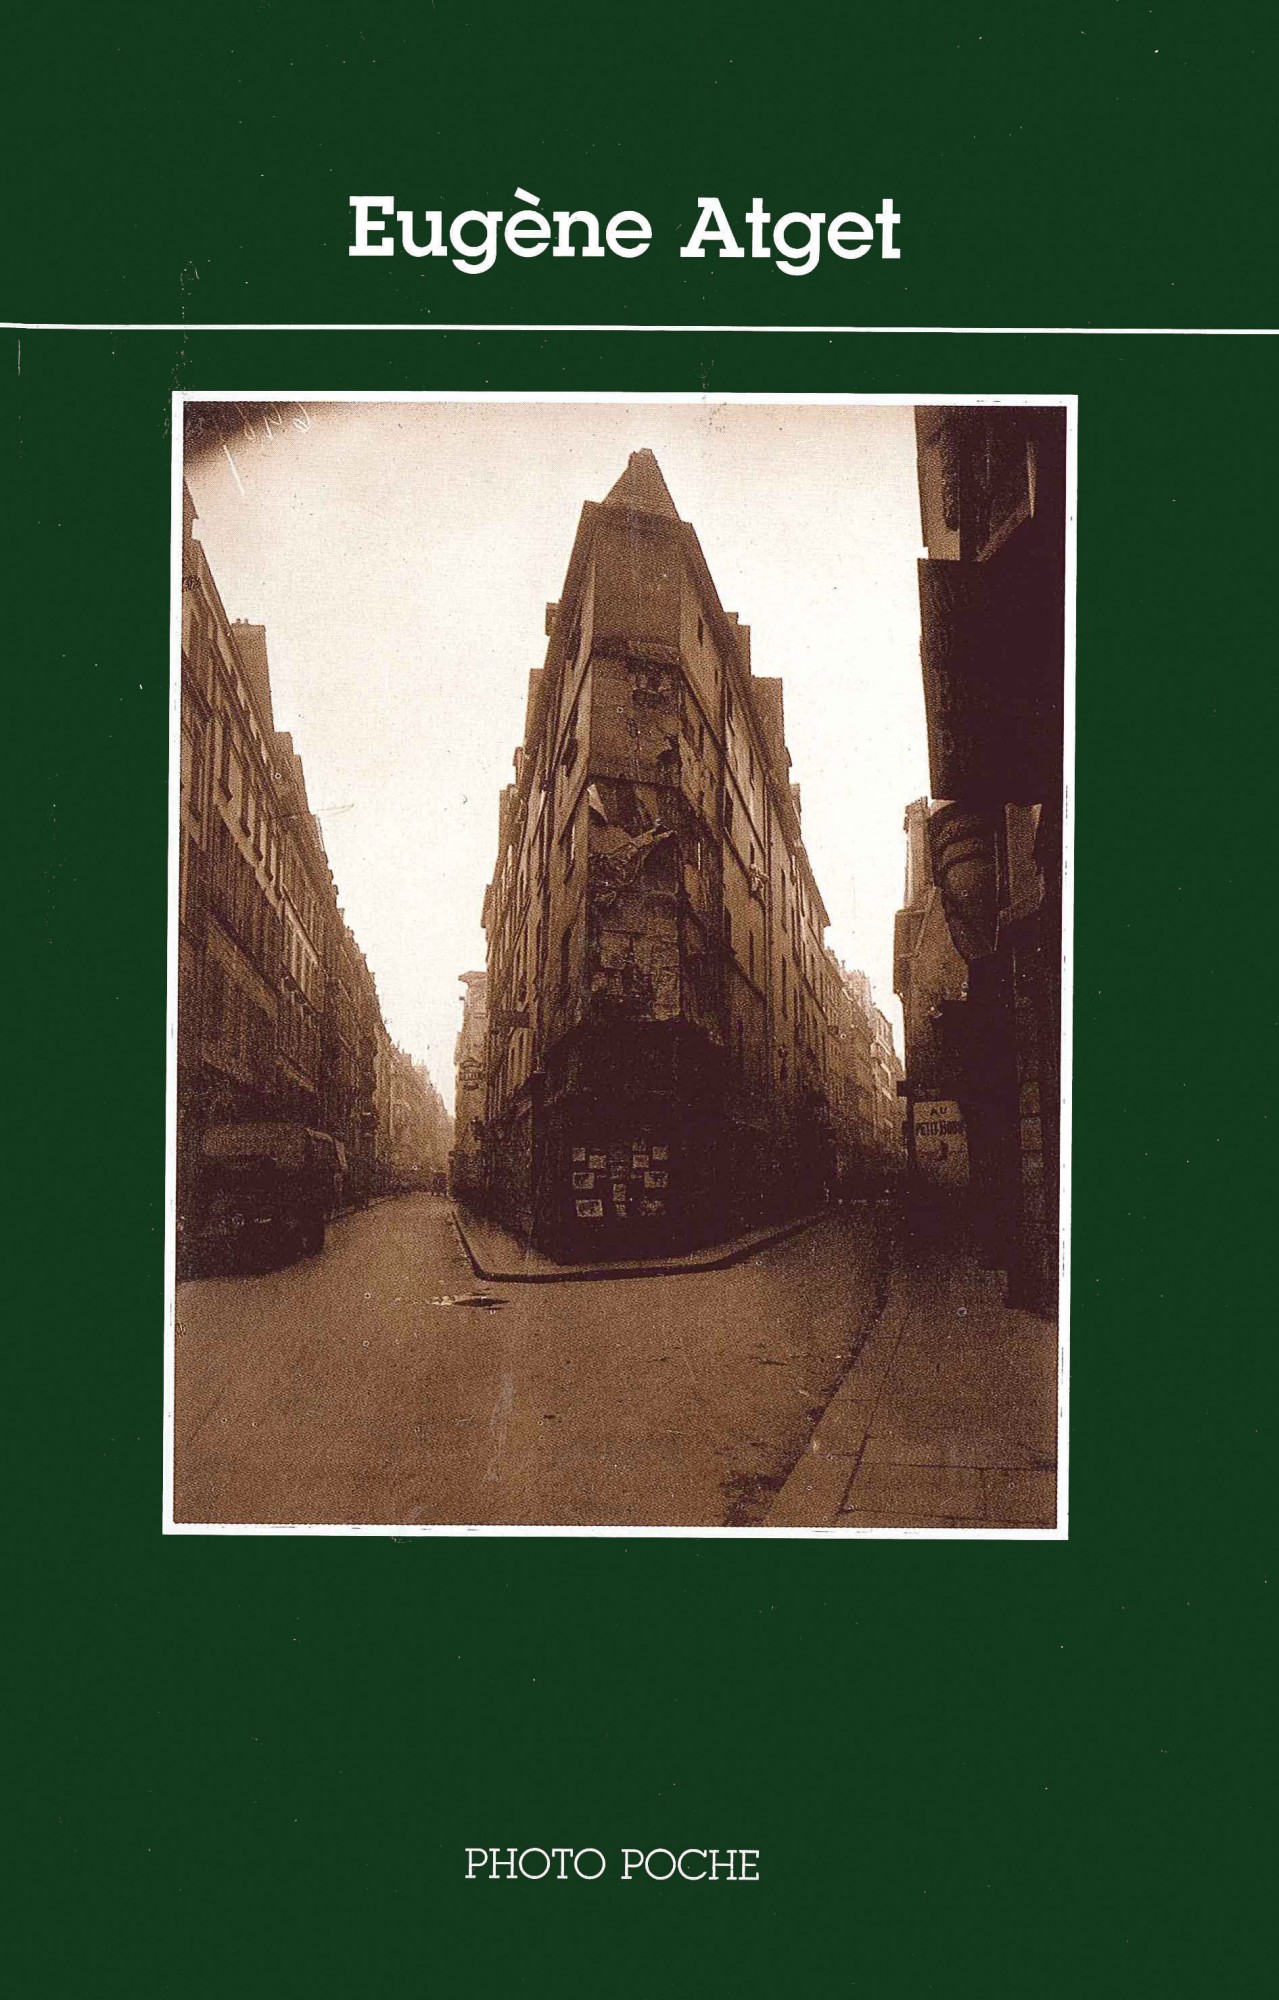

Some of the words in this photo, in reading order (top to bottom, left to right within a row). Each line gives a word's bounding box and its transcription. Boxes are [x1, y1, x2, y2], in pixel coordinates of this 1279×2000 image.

[348, 186, 653, 275] Eugène
[679, 196, 901, 277] Atget
[929, 1106, 949, 1117] AU
[464, 1847, 606, 1880] PHOTO
[620, 1848, 760, 1881] POCHE
